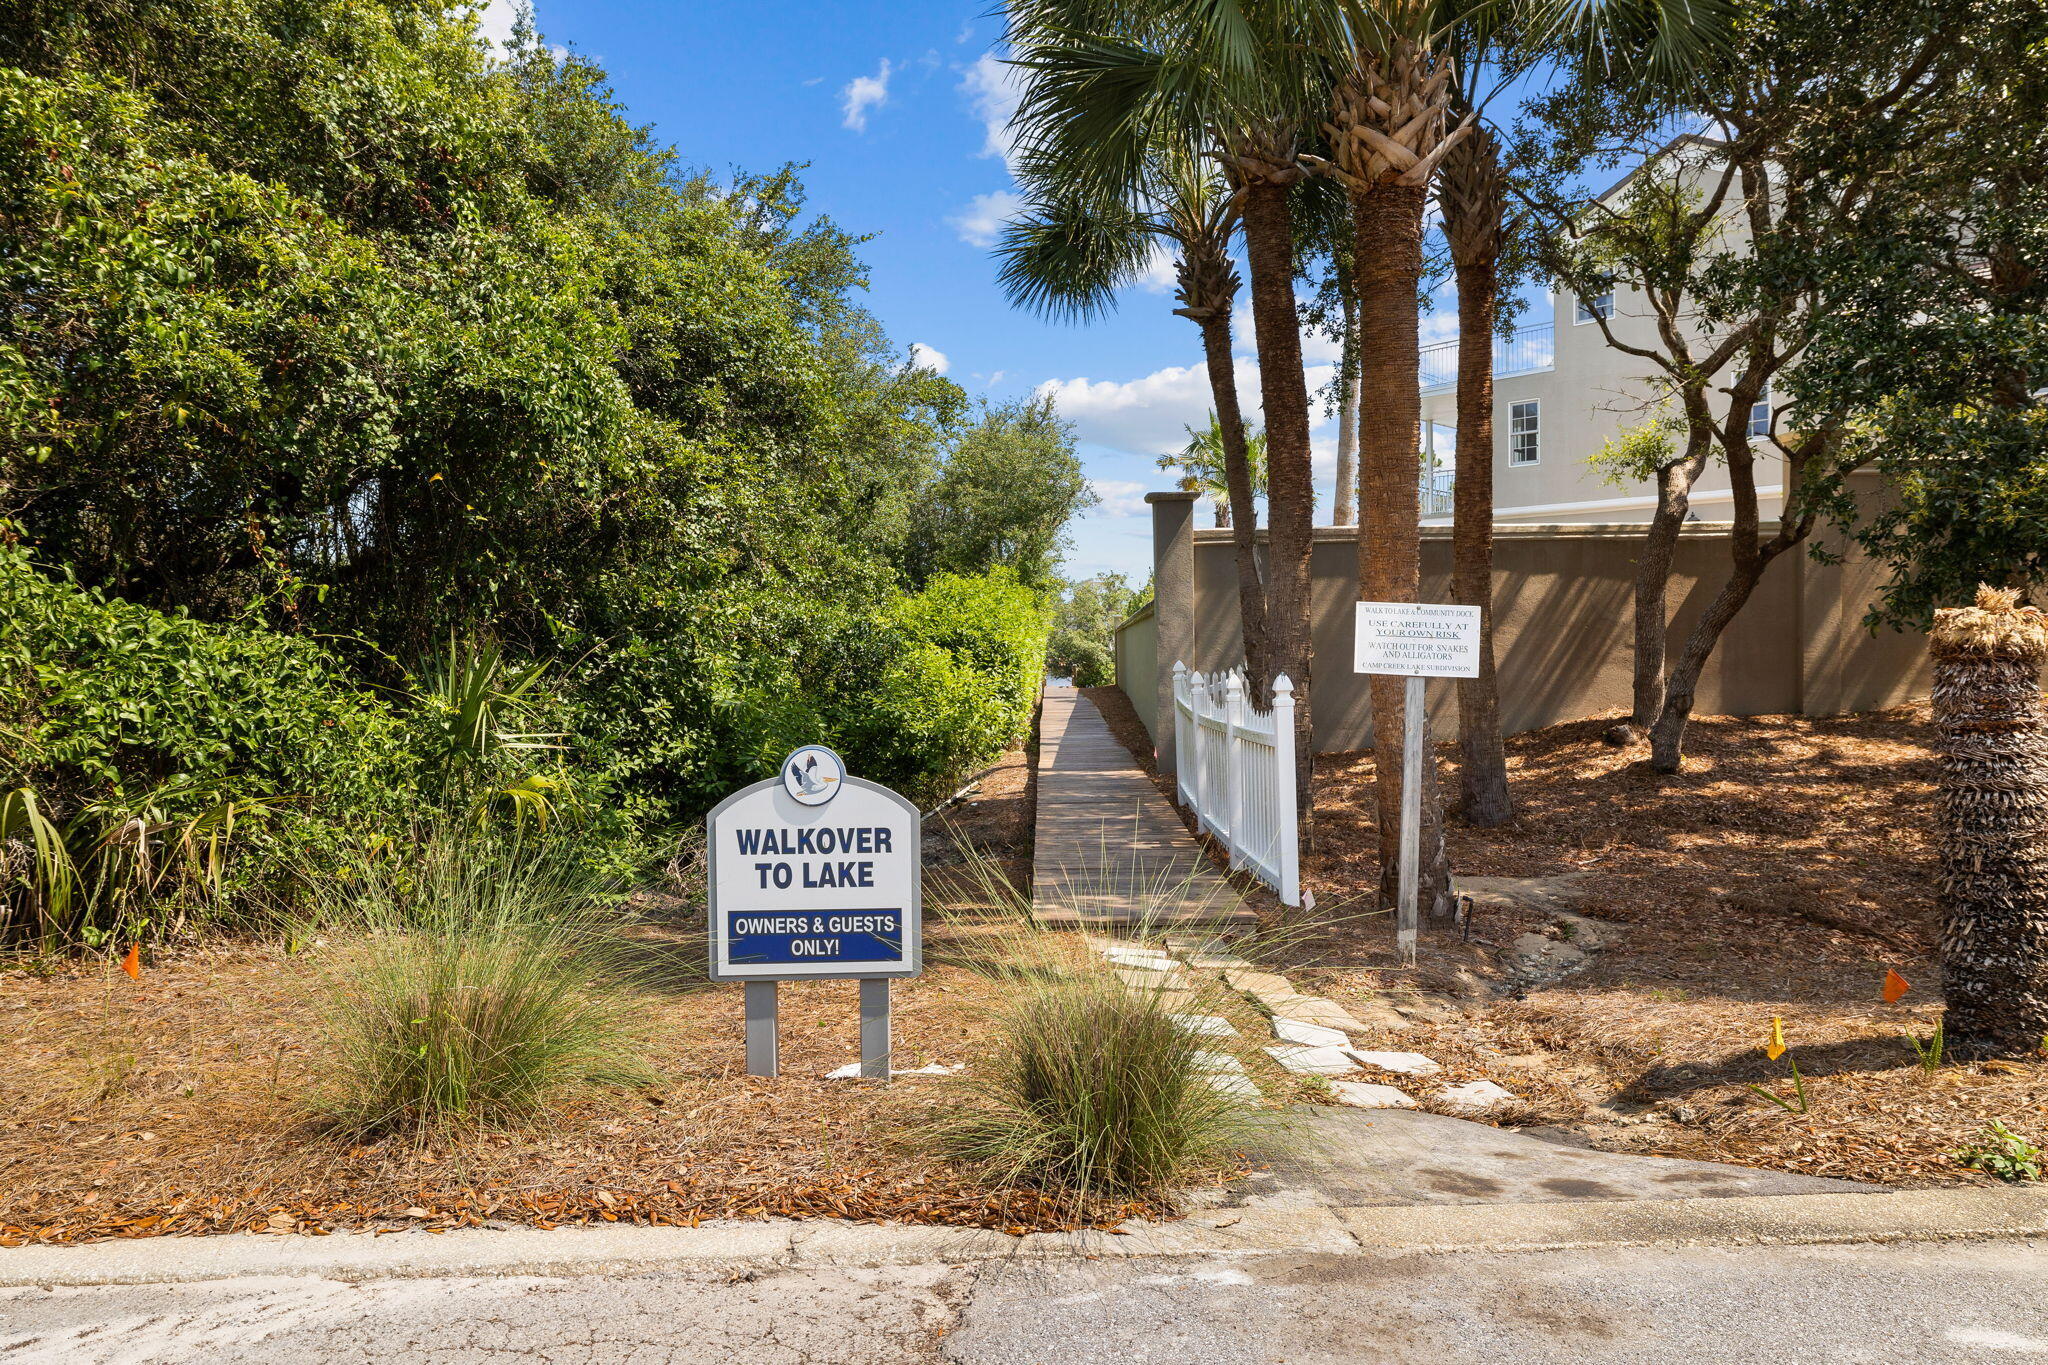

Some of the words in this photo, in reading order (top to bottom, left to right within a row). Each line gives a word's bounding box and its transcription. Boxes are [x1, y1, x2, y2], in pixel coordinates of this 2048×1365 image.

[1416, 609, 1455, 617] COMMUNITY
[1391, 620, 1452, 629] CAREFULLY
[1368, 642, 1398, 650] WATCH
[1437, 645, 1468, 653] SNAKES
[1402, 651, 1452, 660] ALLIGATORS
[736, 827, 892, 855] WALKOVER
[755, 863, 792, 889] TO
[803, 862, 874, 888] LAKE
[736, 918, 808, 934] OWNERS
[813, 918, 824, 932] &
[829, 916, 894, 932] GUESTS
[792, 940, 839, 955] ONLY!
